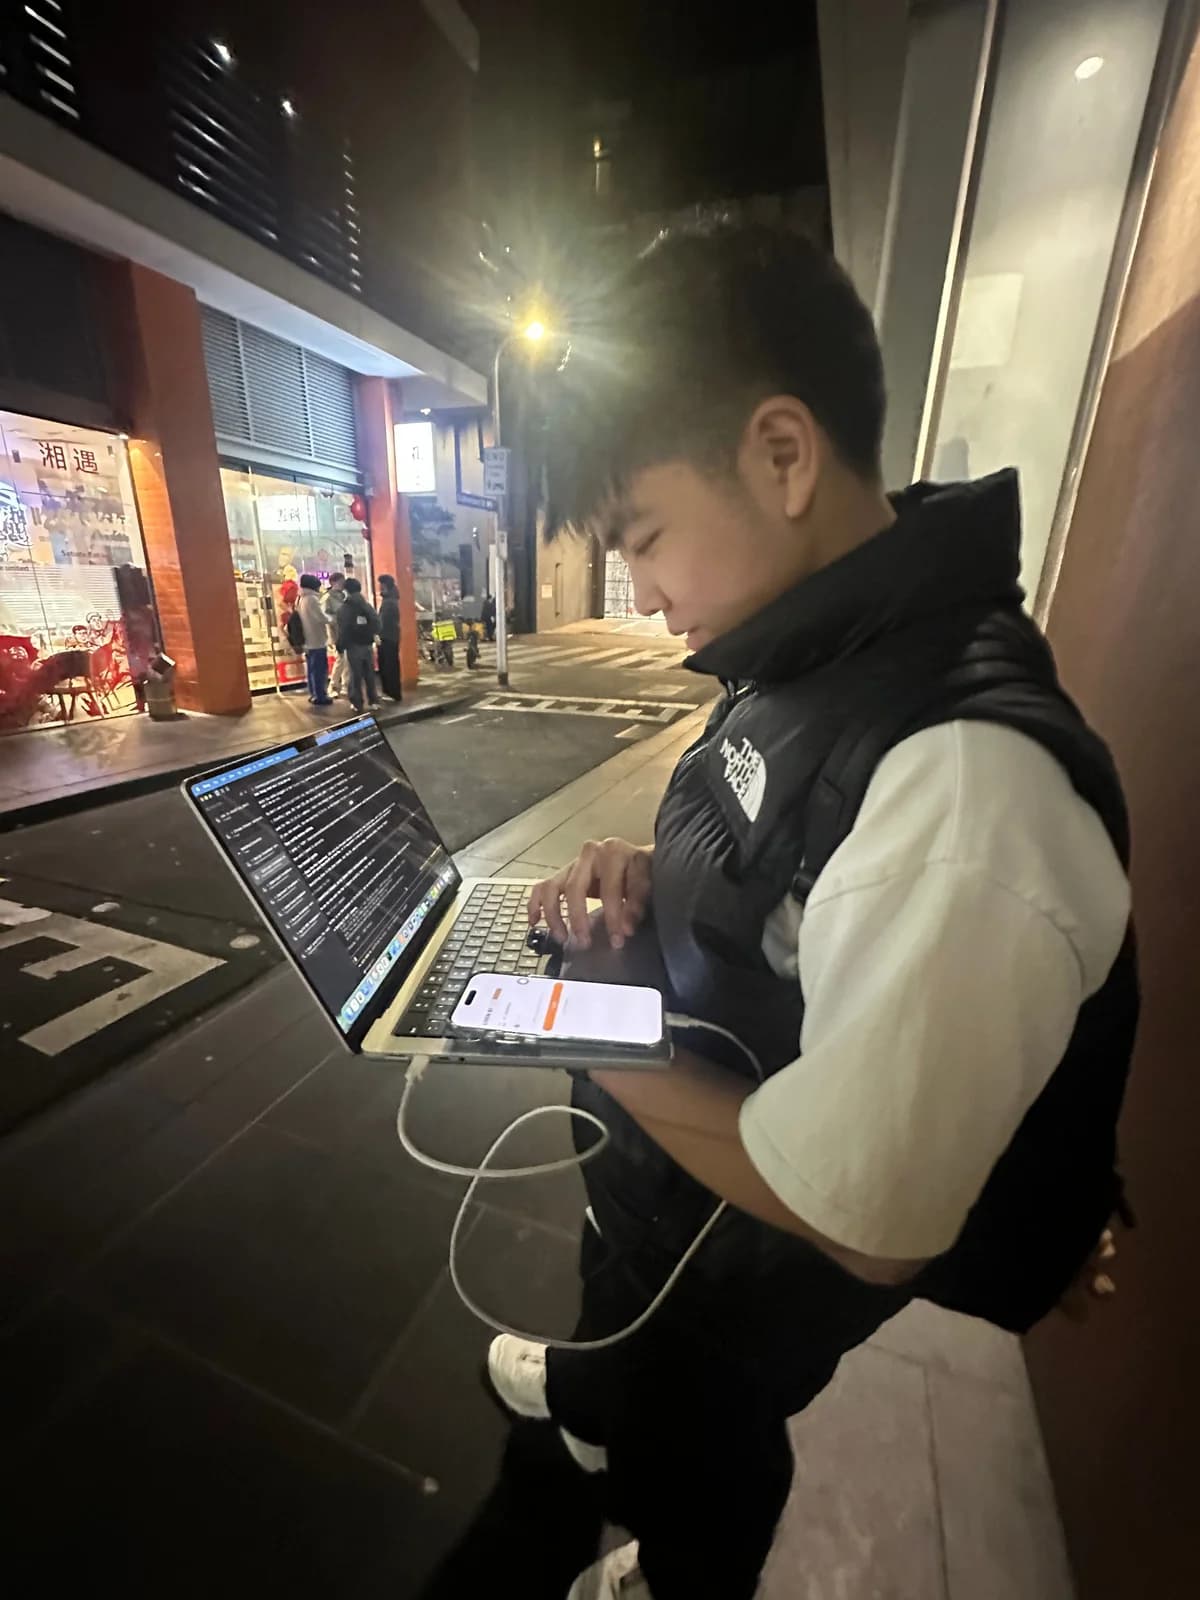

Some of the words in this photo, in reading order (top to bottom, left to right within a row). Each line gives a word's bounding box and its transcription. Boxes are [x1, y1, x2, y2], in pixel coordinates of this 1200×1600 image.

[39, 442, 99, 475] 湘遇
[719, 738, 757, 785] NORTH
[740, 737, 763, 768] THE
[723, 763, 747, 800] FACE
